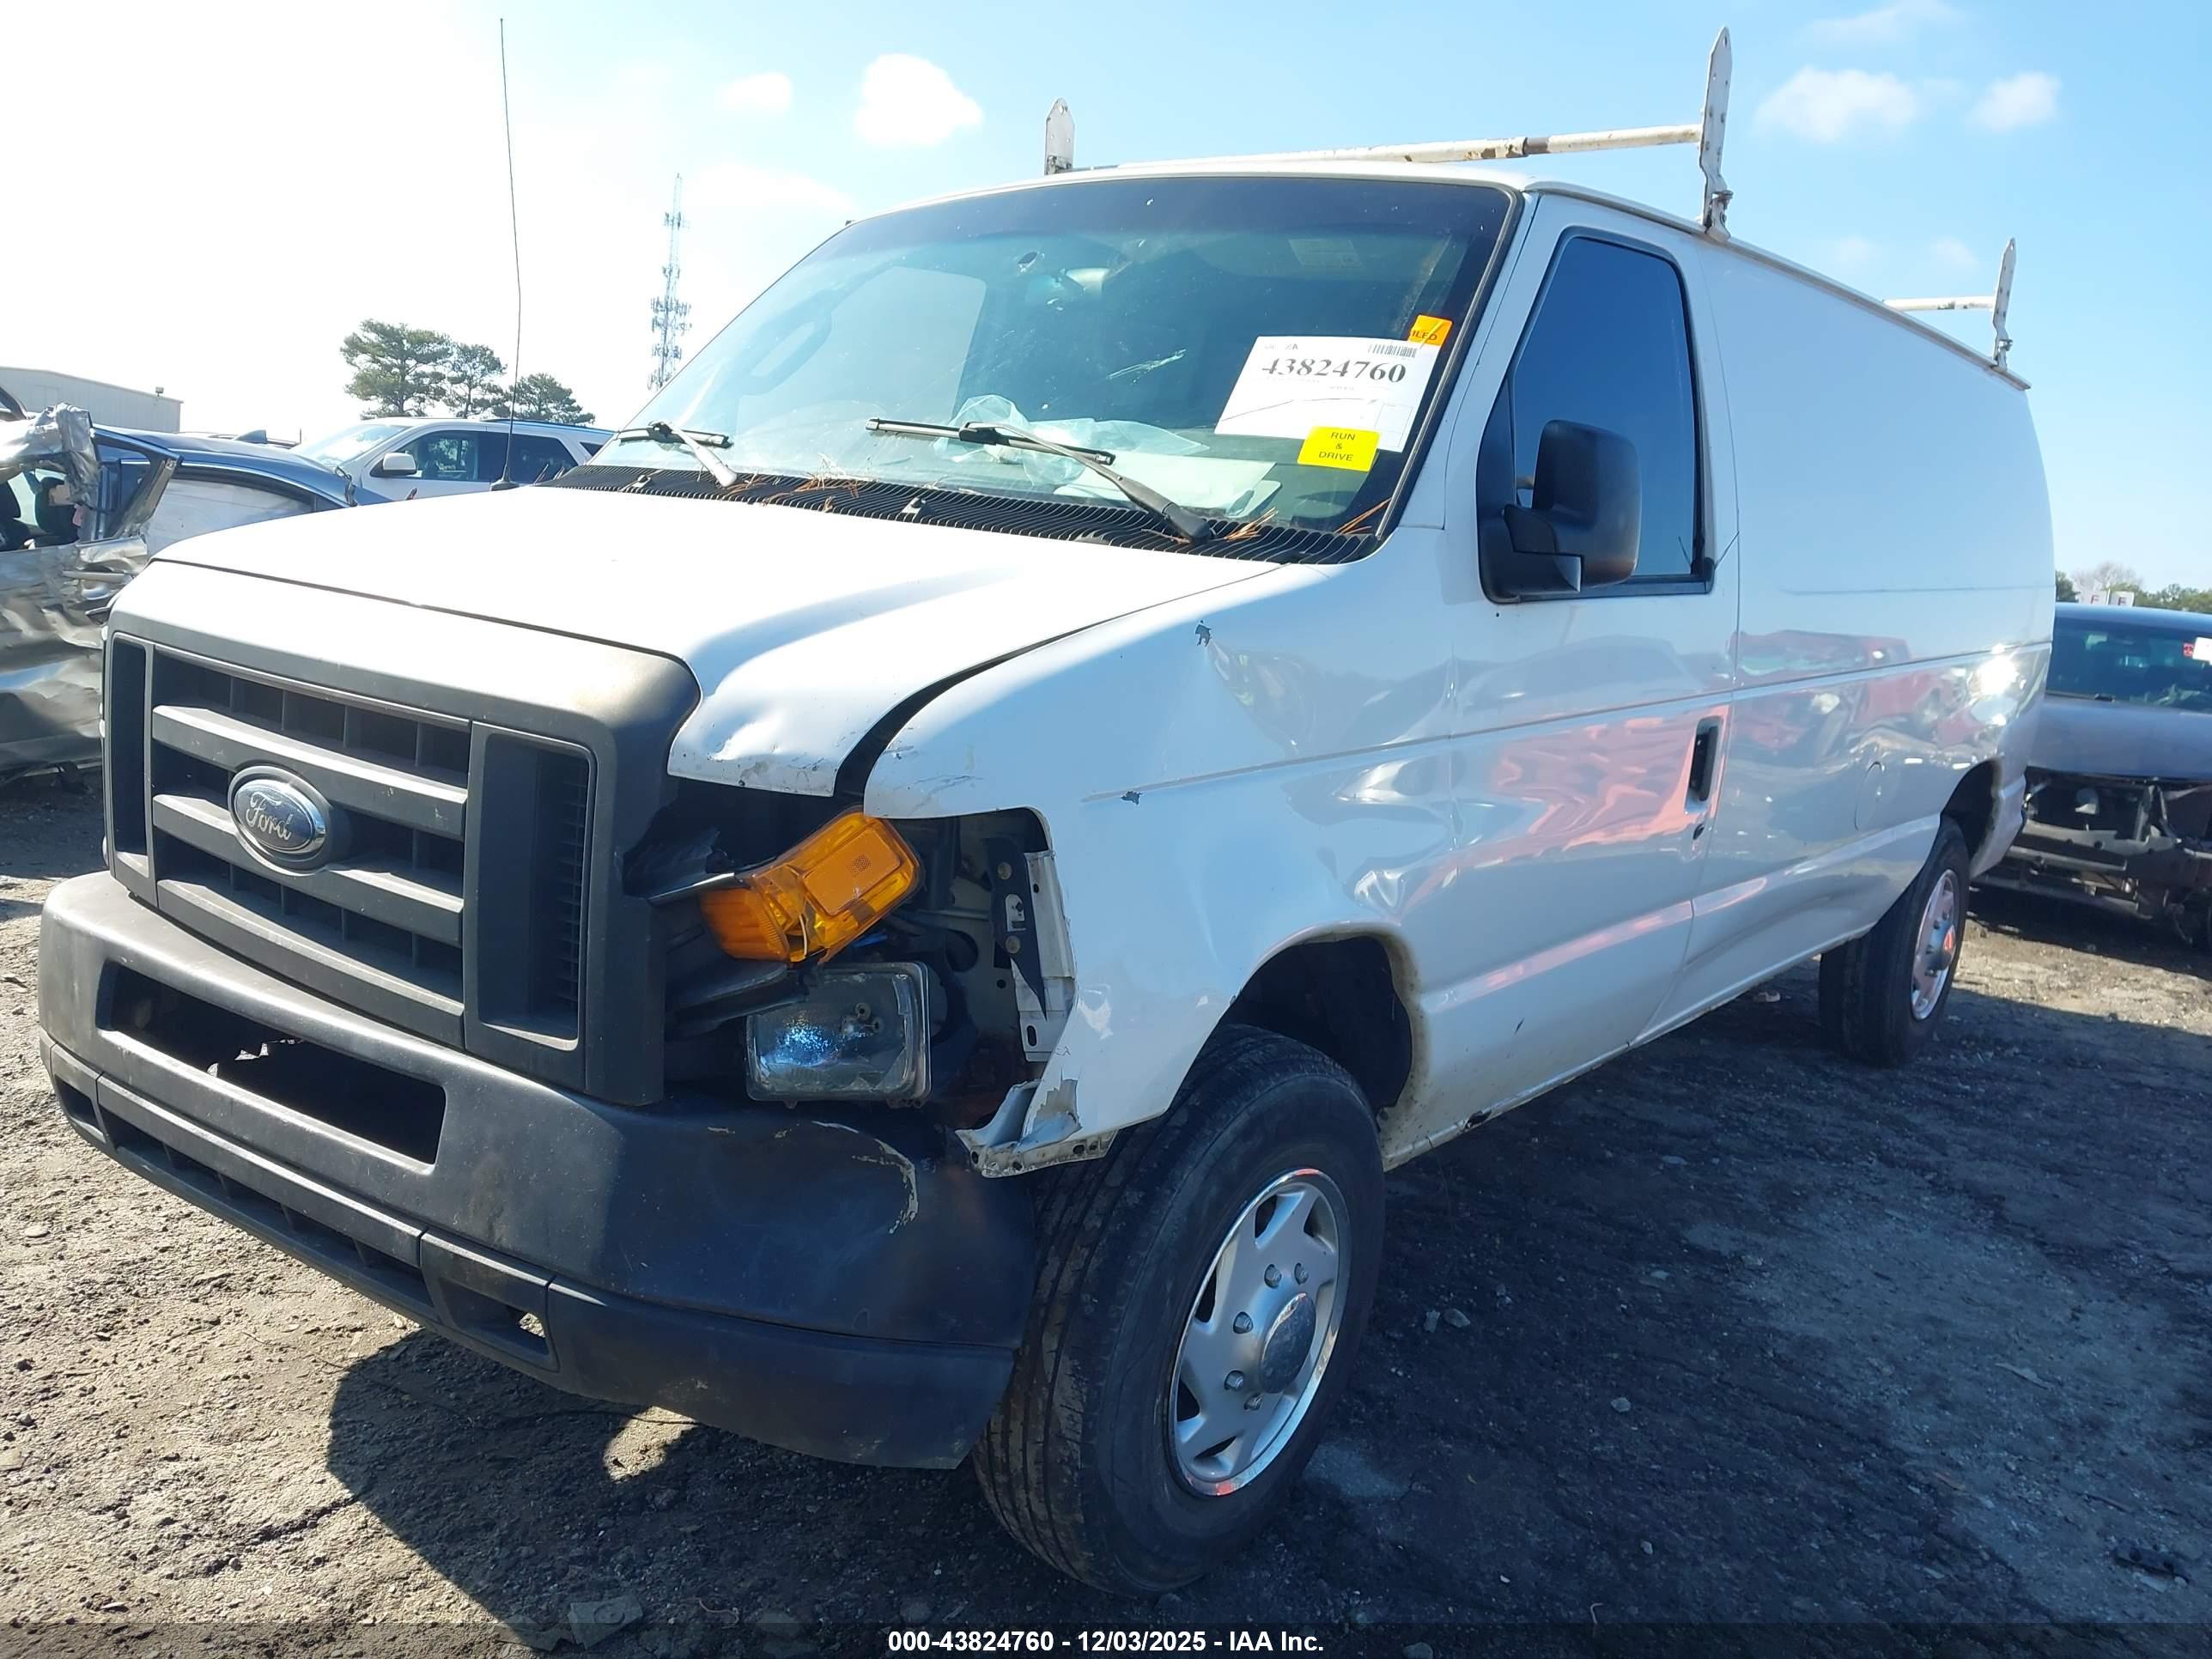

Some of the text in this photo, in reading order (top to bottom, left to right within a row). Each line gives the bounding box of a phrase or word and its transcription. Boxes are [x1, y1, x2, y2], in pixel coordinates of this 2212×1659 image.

[1261, 357, 1407, 383] 43824760
[1330, 431, 1357, 441] RUN
[1318, 451, 1354, 462] DRIVE
[245, 791, 294, 841] Ford
